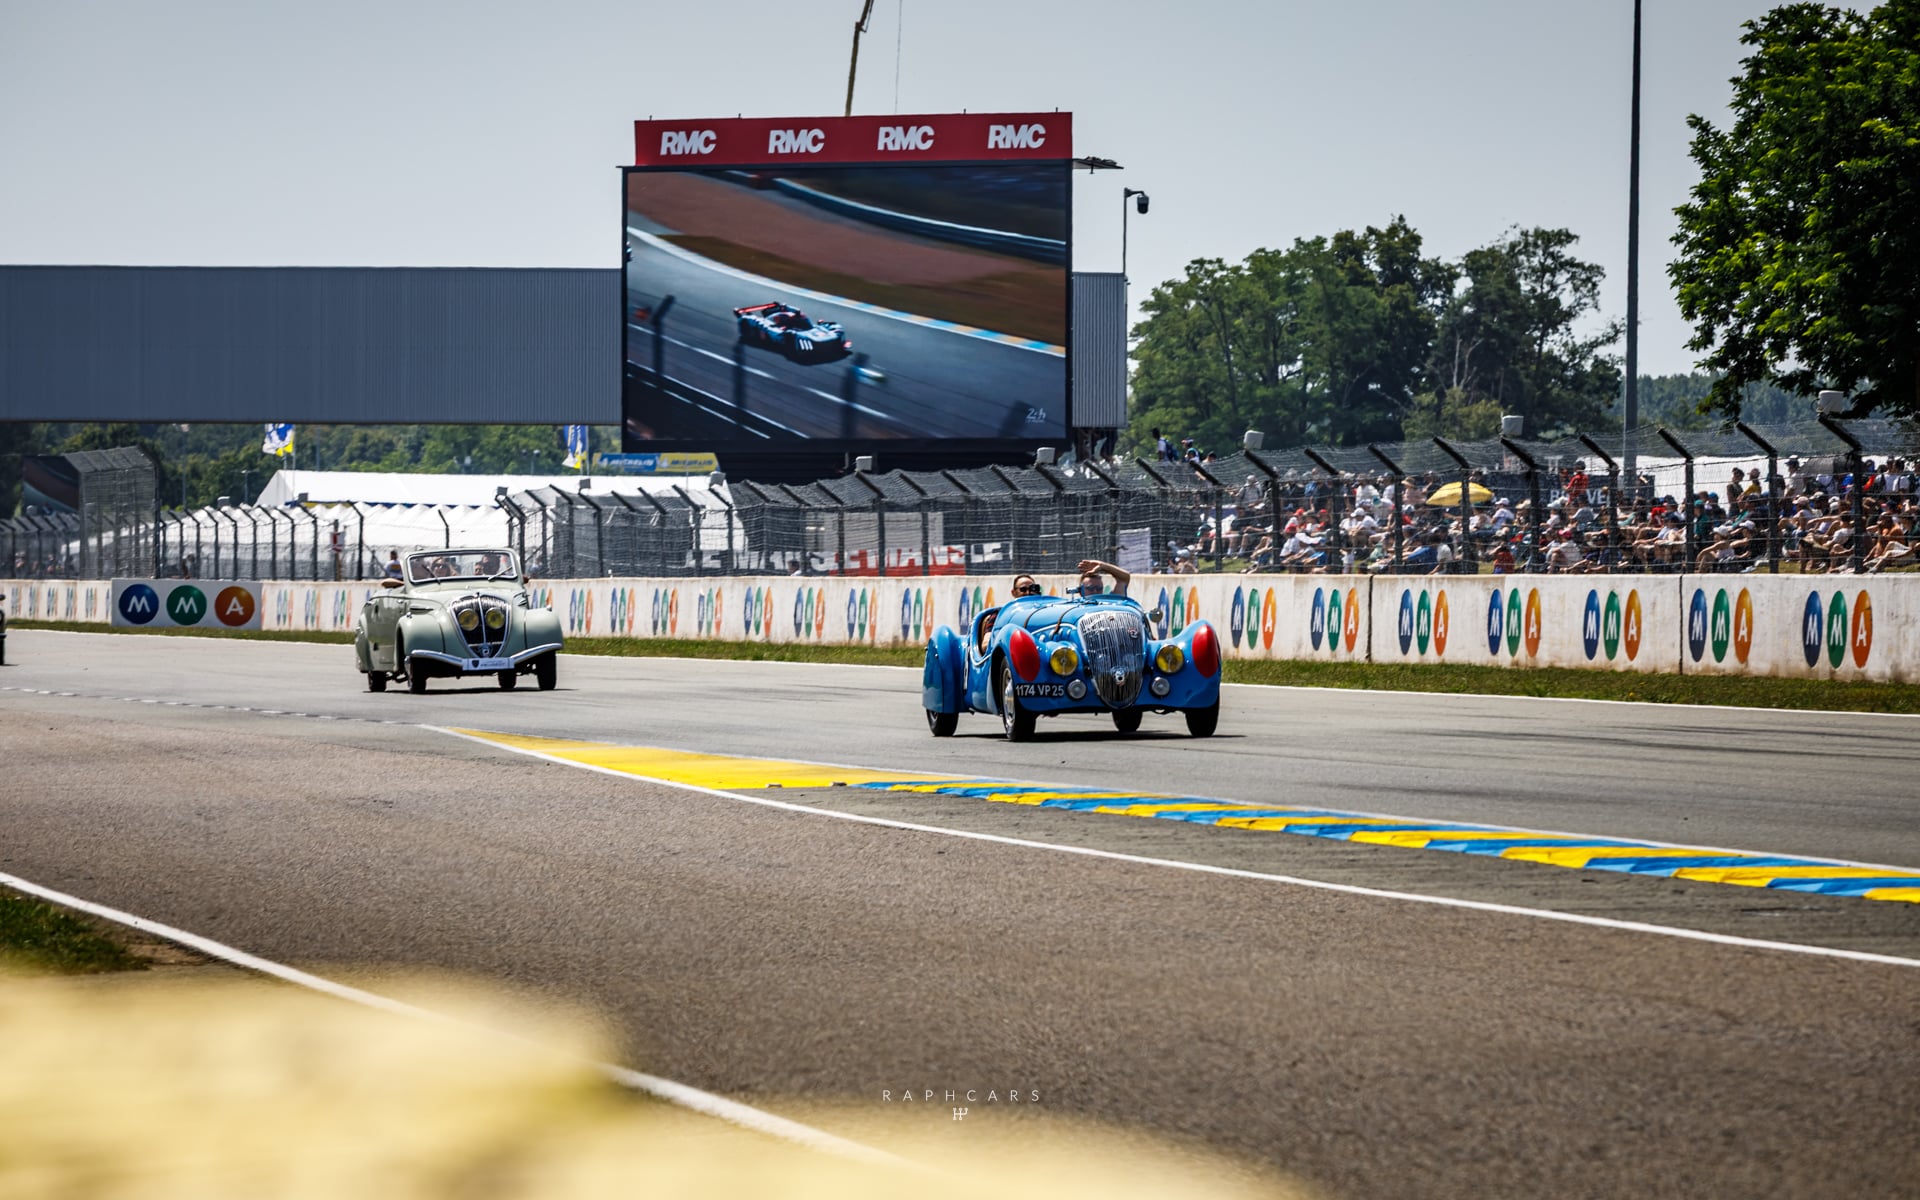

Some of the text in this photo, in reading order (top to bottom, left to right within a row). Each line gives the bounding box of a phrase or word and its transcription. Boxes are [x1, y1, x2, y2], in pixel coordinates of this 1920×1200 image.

[660, 130, 717, 155] RMC
[768, 128, 825, 153] RMC
[877, 125, 935, 150] RMC
[987, 123, 1046, 149] RMC
[127, 595, 244, 616] MMA
[1232, 604, 1273, 632] MMA
[1312, 605, 1355, 634] MMA
[1400, 608, 1445, 638] MMA
[1489, 608, 1537, 638] MMA
[1585, 609, 1637, 640] MMA
[1691, 609, 1748, 642] MMA
[1805, 612, 1867, 647] MMA
[1015, 684, 1065, 697] 1174 VP 25
